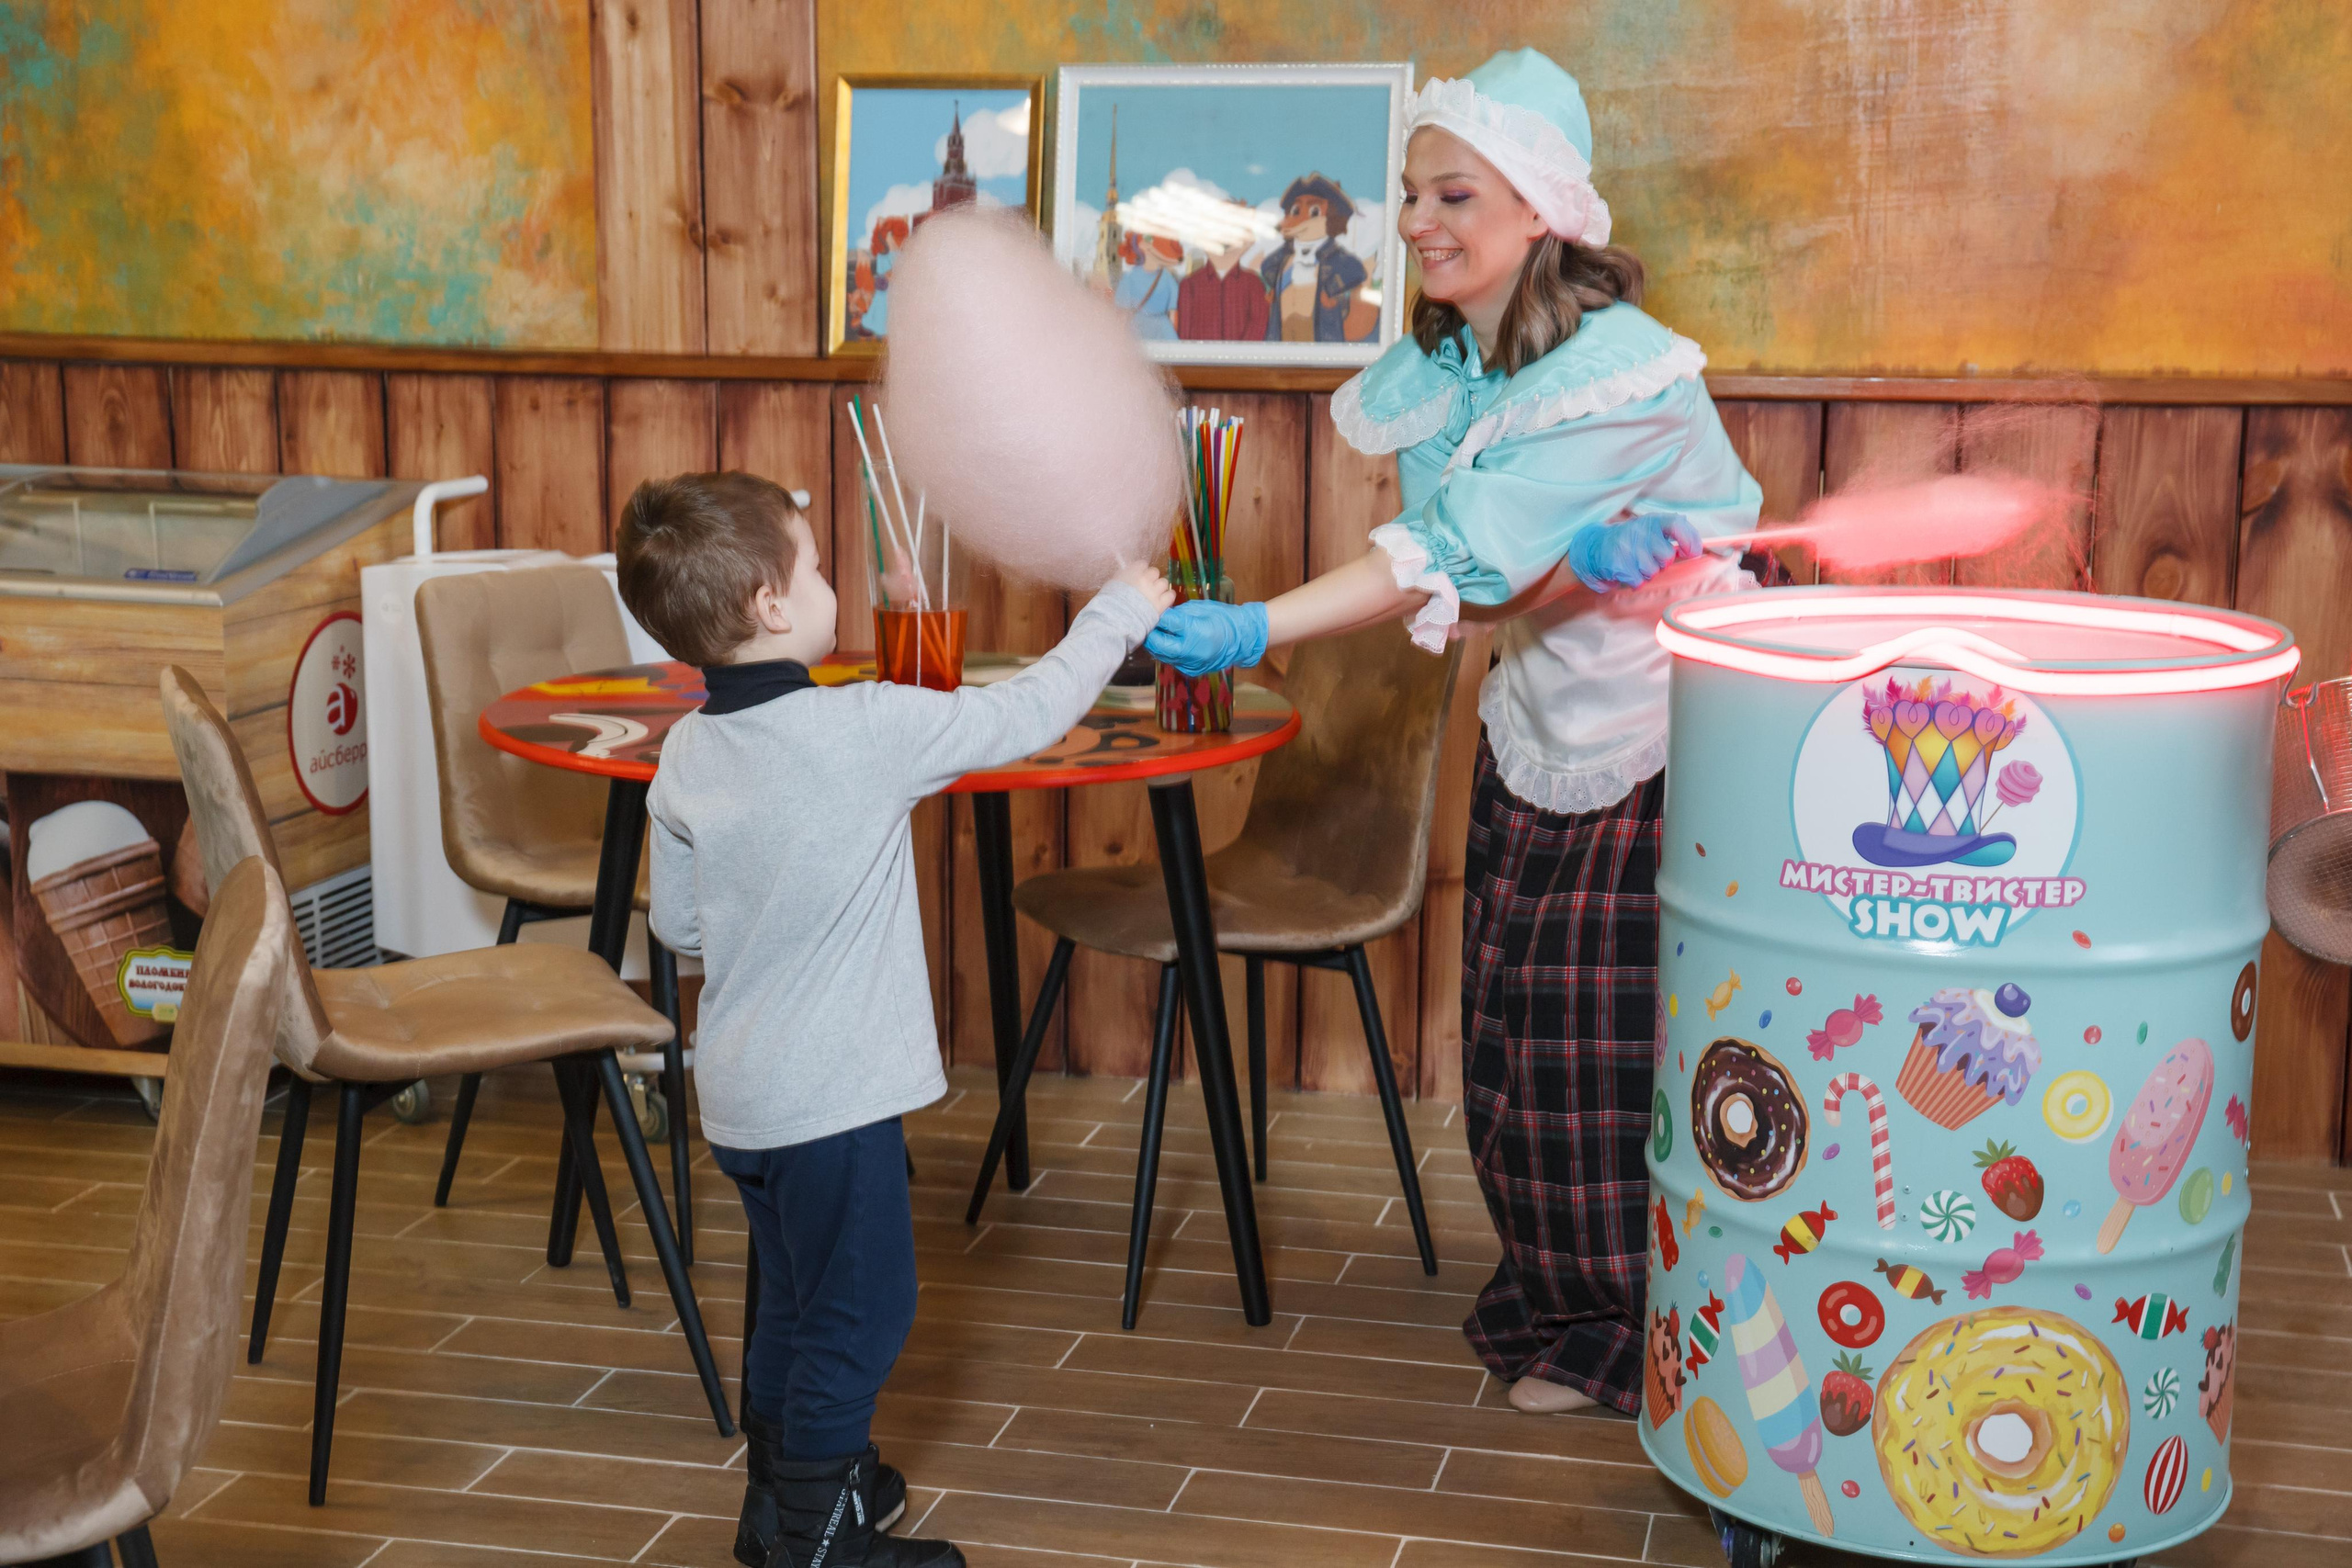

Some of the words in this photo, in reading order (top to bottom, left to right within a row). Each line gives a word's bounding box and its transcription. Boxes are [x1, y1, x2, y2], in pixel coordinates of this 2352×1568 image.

[310, 742, 368, 773] айсберр
[1781, 861, 2086, 907] МИСТЕР-ТВИСТЕР
[1852, 897, 2007, 945] SHOW
[129, 978, 186, 992] ВОЛОГОДСК
